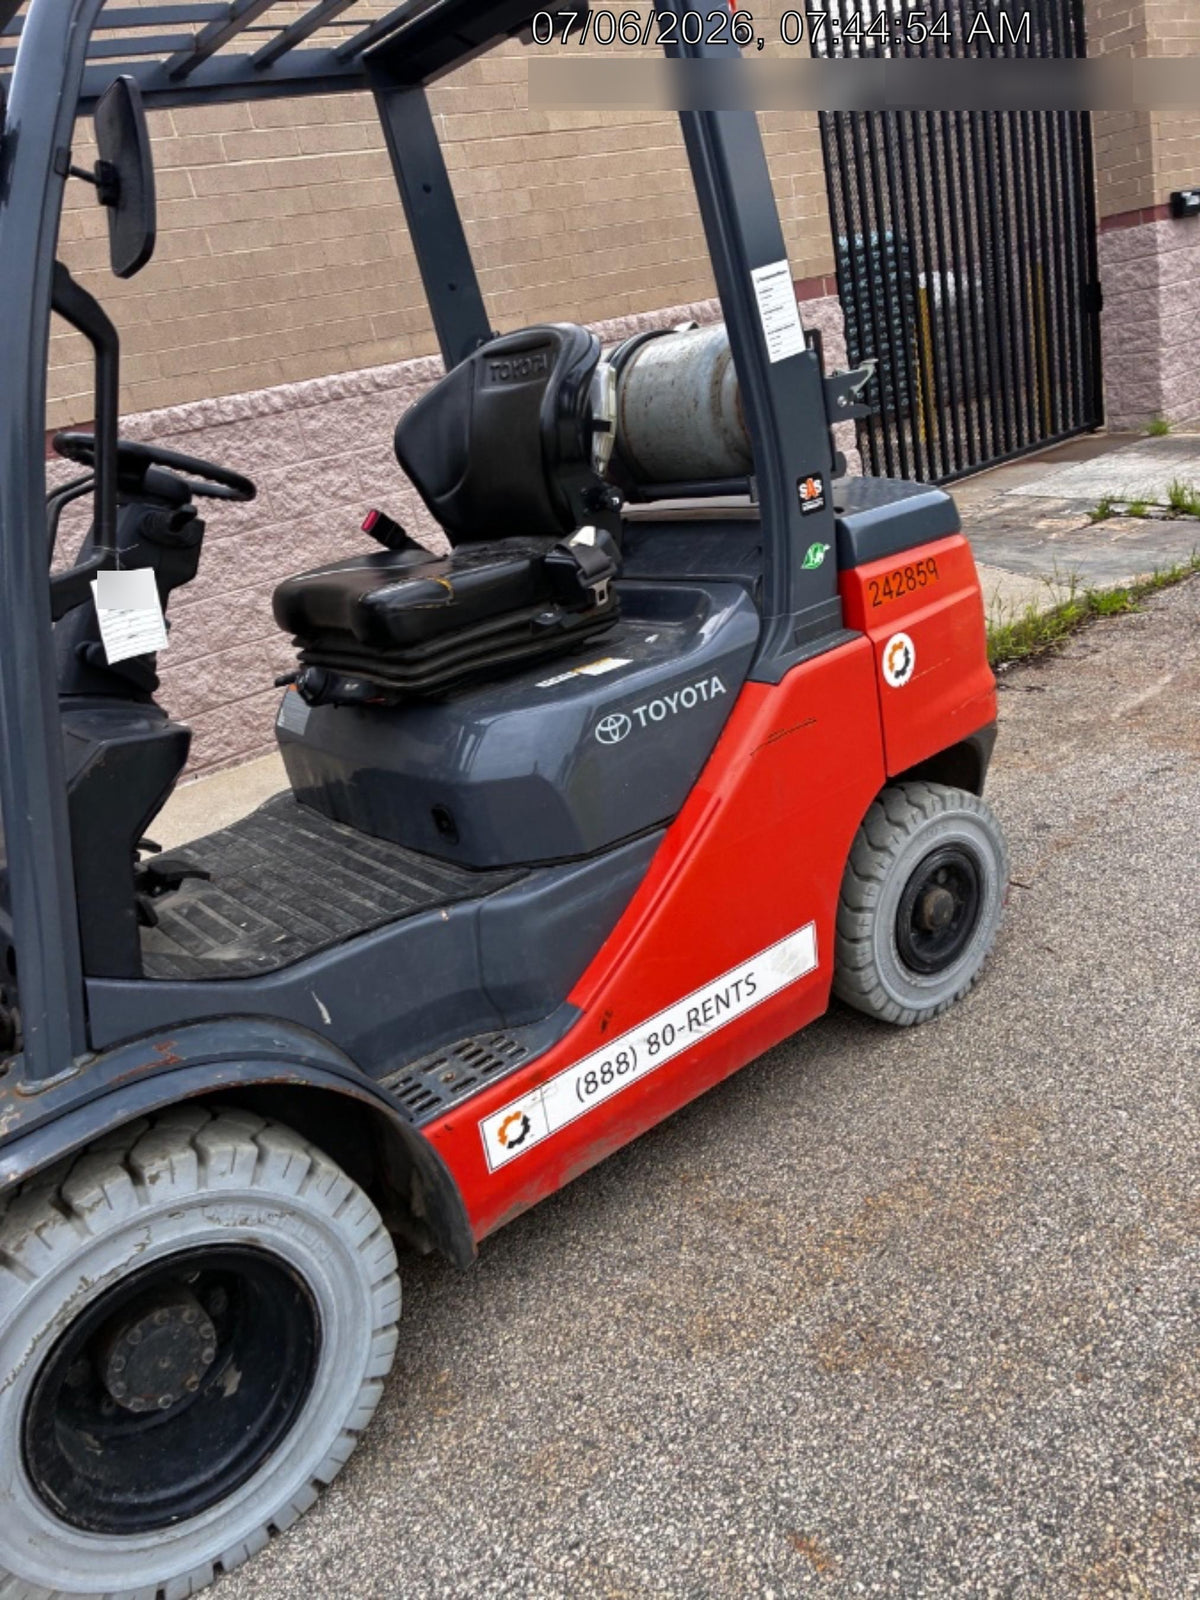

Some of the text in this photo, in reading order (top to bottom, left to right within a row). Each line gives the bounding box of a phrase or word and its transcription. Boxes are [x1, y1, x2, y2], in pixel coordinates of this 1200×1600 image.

[798, 477, 823, 500] SAS
[868, 556, 940, 608] 242859
[632, 675, 727, 728] TOYOTA
[574, 972, 758, 1103] (888) 80-RENTS
